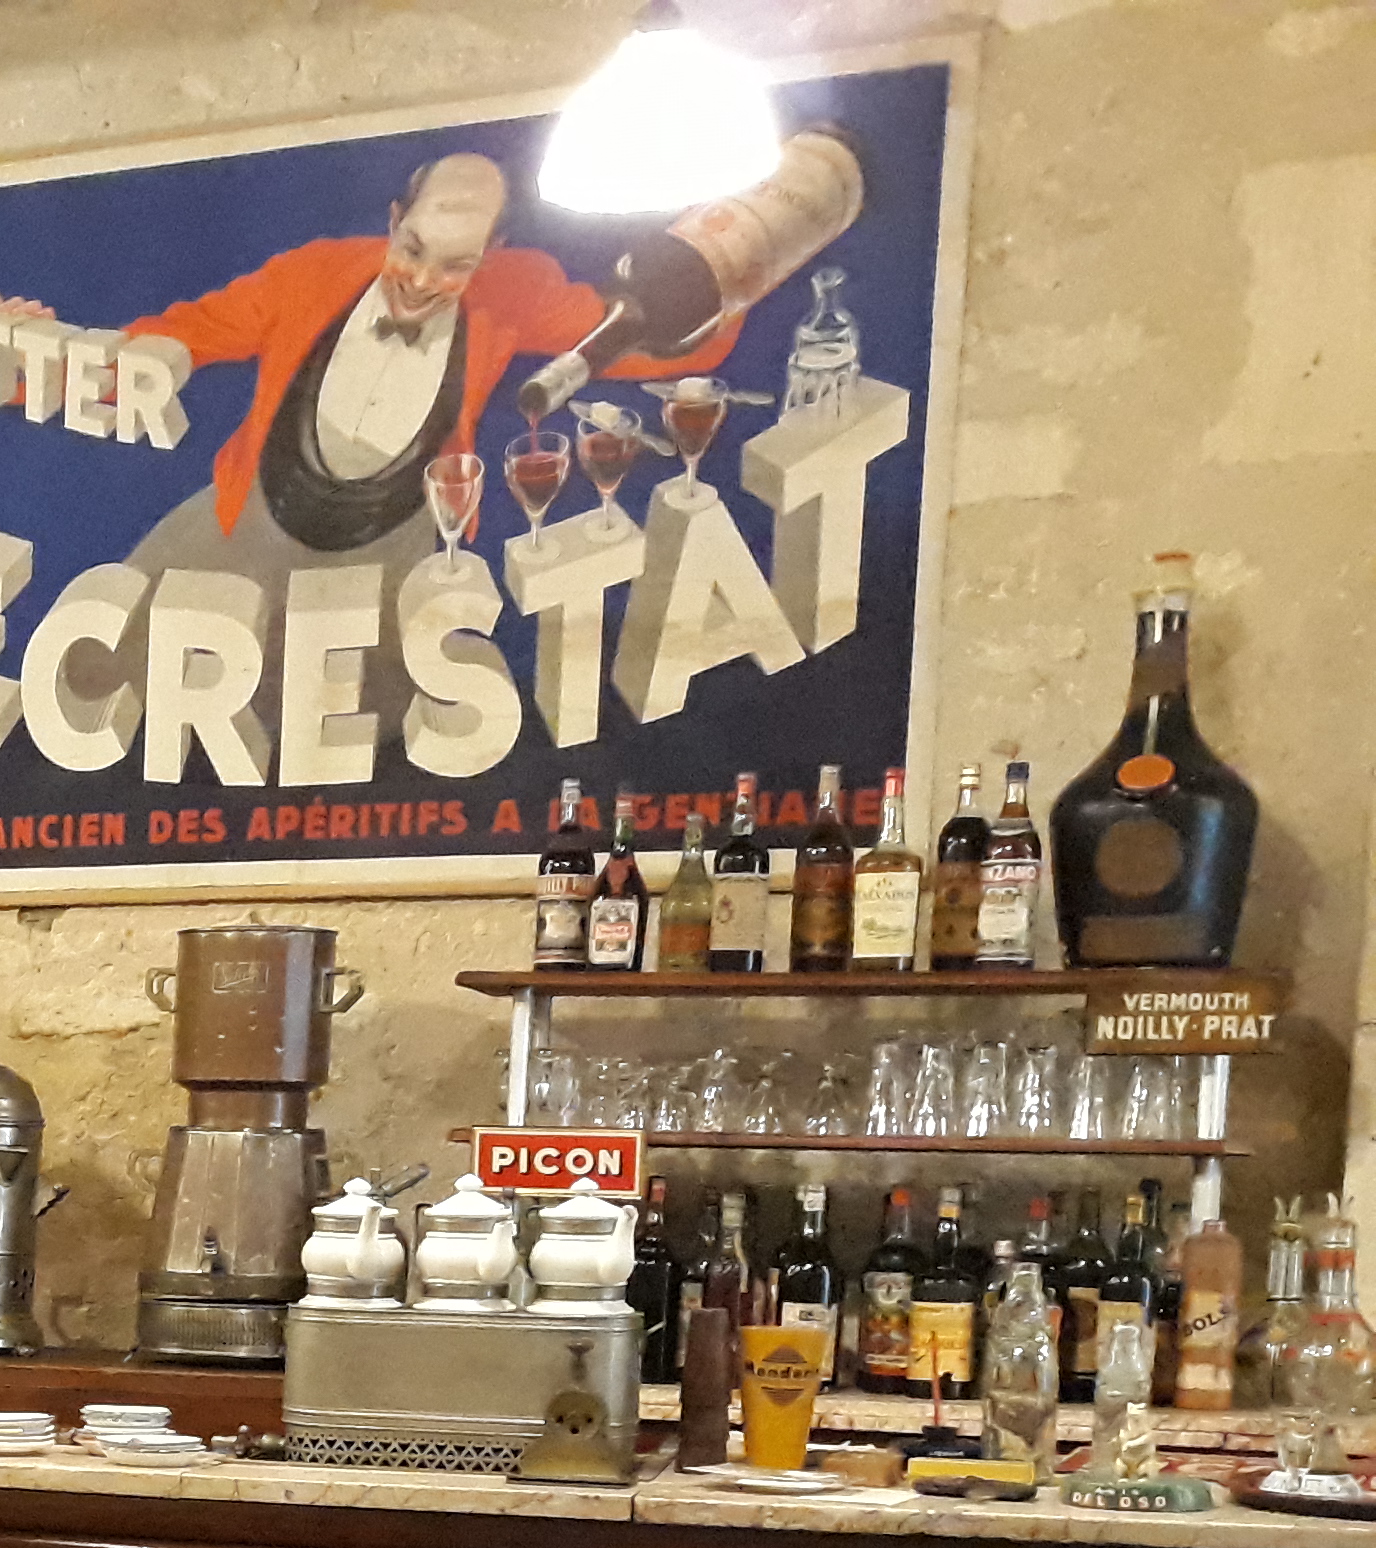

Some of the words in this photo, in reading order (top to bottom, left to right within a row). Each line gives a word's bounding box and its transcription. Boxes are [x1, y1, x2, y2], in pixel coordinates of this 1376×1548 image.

[148, 808, 228, 845] DES
[491, 798, 523, 836] A
[1123, 991, 1249, 1013] VERMOUTH
[491, 1146, 622, 1176] PICON
